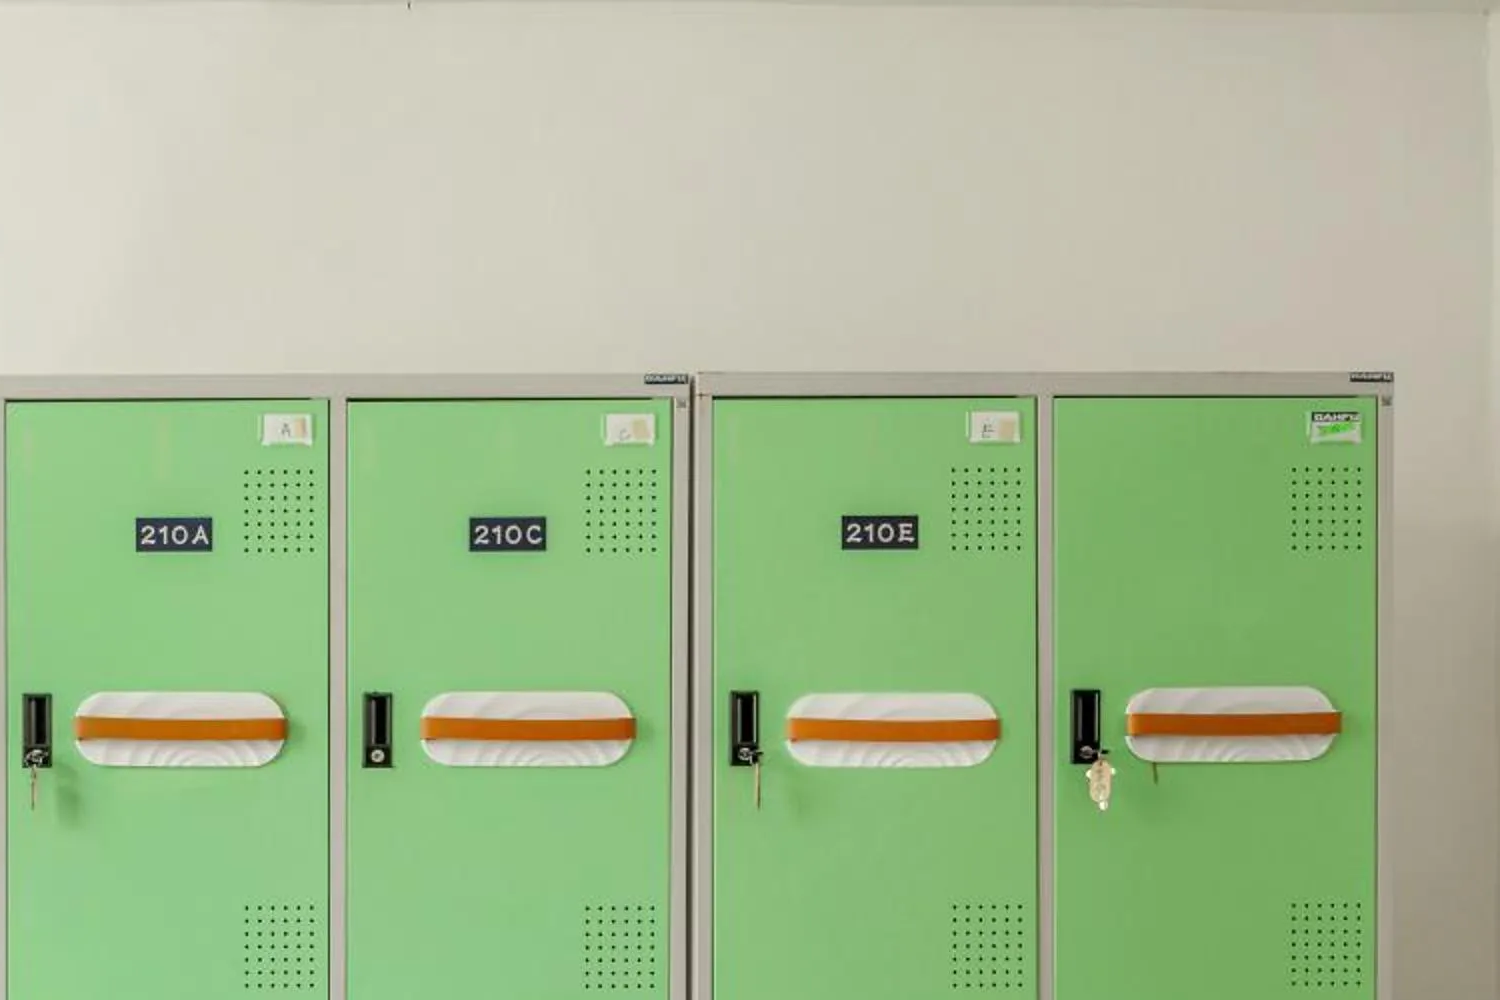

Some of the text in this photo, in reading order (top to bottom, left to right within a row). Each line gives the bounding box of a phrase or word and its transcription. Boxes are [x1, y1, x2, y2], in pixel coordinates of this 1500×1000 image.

[140, 524, 209, 545] 210A
[474, 524, 543, 545] 210C
[846, 523, 915, 543] 210E
